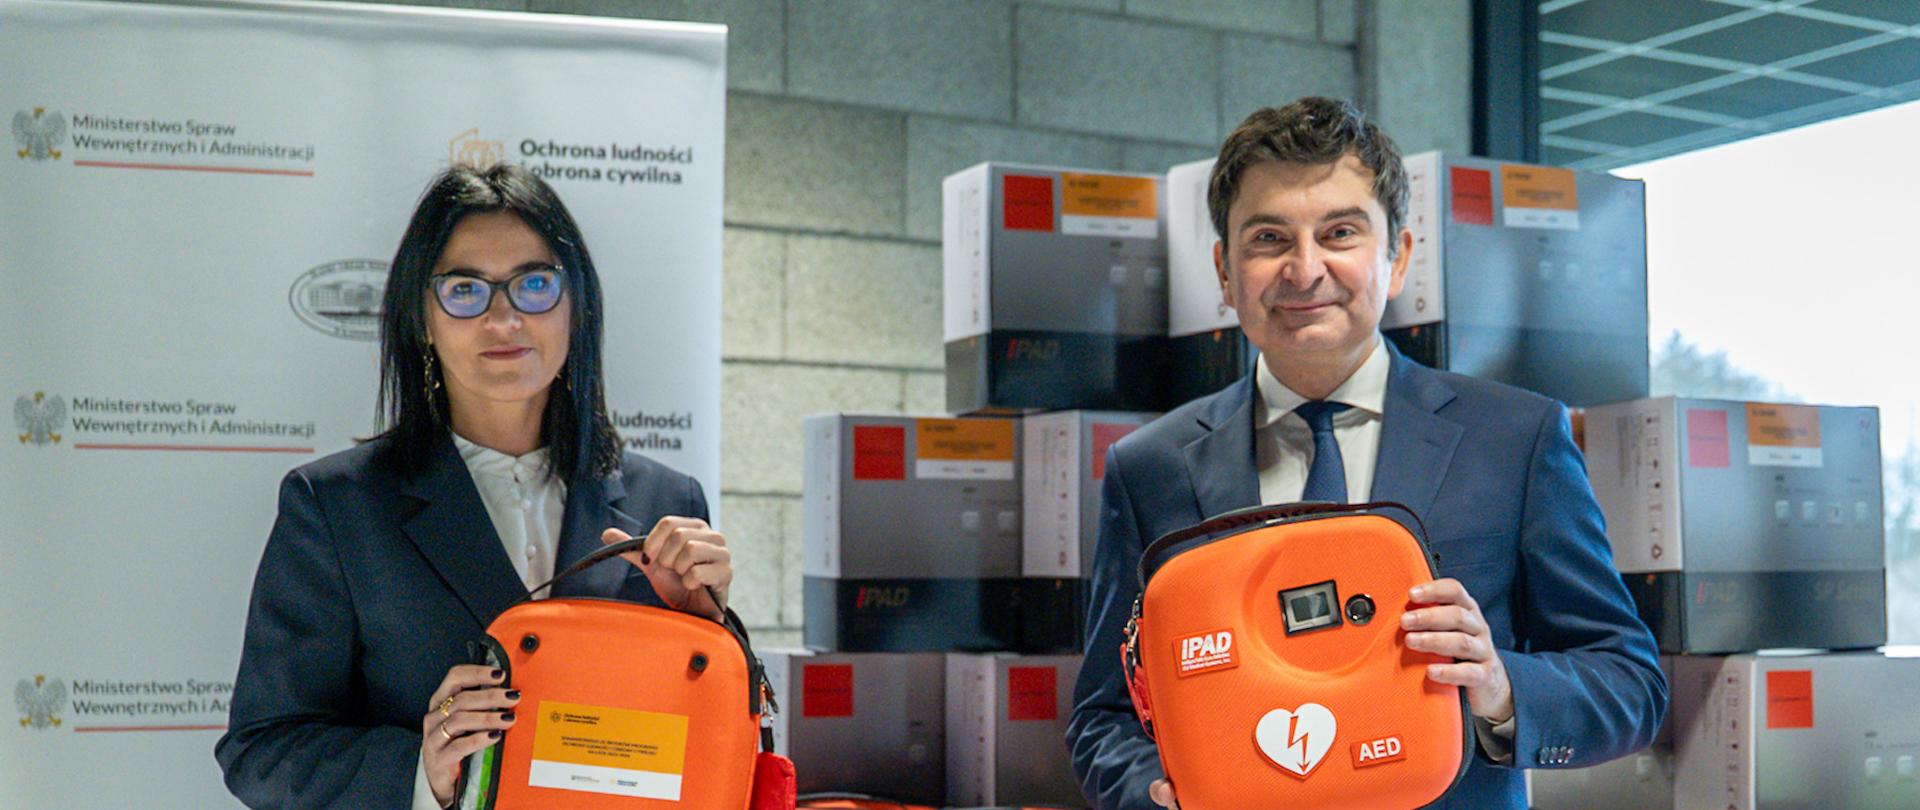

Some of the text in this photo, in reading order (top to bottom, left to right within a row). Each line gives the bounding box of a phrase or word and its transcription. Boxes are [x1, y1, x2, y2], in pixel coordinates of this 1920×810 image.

[73, 114, 236, 137] Ministerstwo Spraw
[72, 135, 315, 162] Wewnętrznych i Administracji
[520, 139, 693, 163] Ochrona ludności
[531, 162, 601, 181] obrona
[607, 166, 682, 184] cywilna
[73, 397, 236, 417] Ministerstwo Spraw
[72, 417, 315, 438] Wewnętrznych i Administracji
[612, 410, 692, 429] ludności
[856, 586, 910, 609] IPAD
[1182, 631, 1232, 660] IPAD
[73, 680, 182, 696] Ministerstwo
[72, 699, 197, 716] Wewnętrznych
[201, 699, 206, 713] i
[1359, 737, 1401, 762] AED
